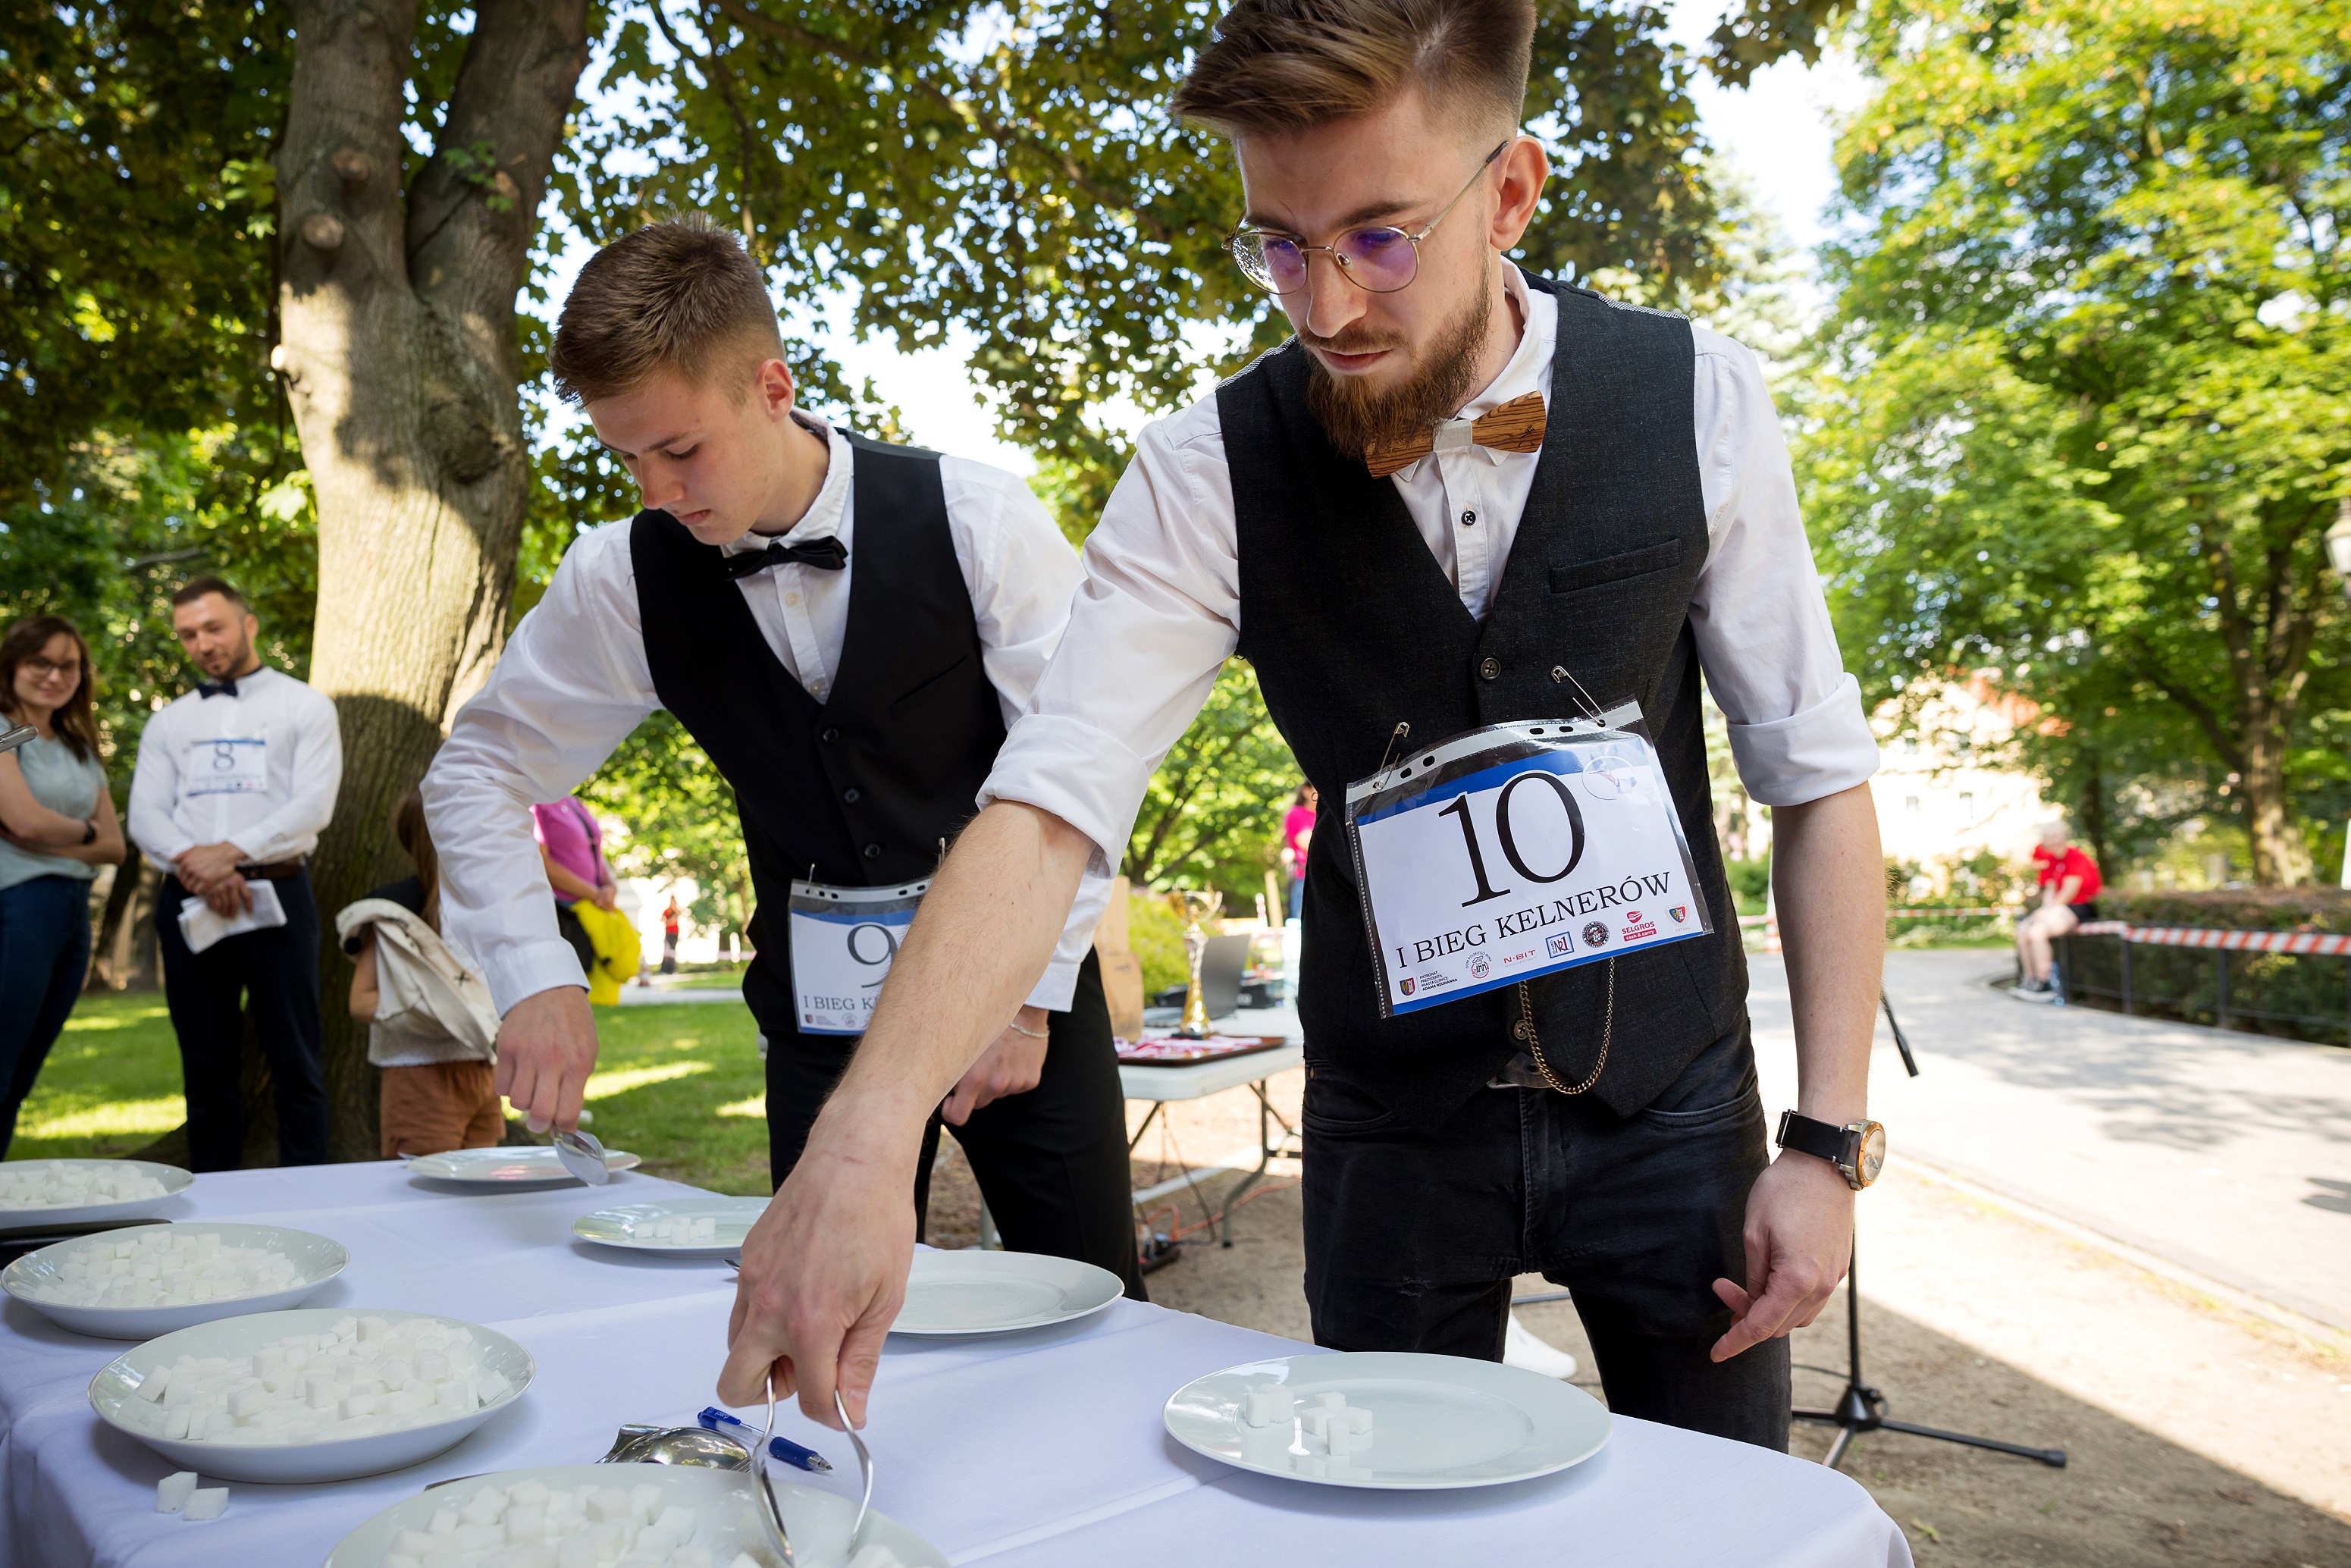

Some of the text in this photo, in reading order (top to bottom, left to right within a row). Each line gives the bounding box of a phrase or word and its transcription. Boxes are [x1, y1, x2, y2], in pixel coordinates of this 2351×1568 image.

[212, 740, 235, 773] 8
[1438, 771, 1585, 908] 10
[1396, 947, 1408, 969] I
[1412, 924, 1487, 963] BIEG
[1494, 871, 1671, 939] KELNERÓW
[1621, 920, 1655, 935] SELGROS
[847, 924, 898, 988] 9
[1419, 971, 1438, 979] PATRONAT
[1436, 978, 1458, 987] NEUMANNA
[804, 996, 809, 1008] I
[813, 996, 855, 1011] BIEG
